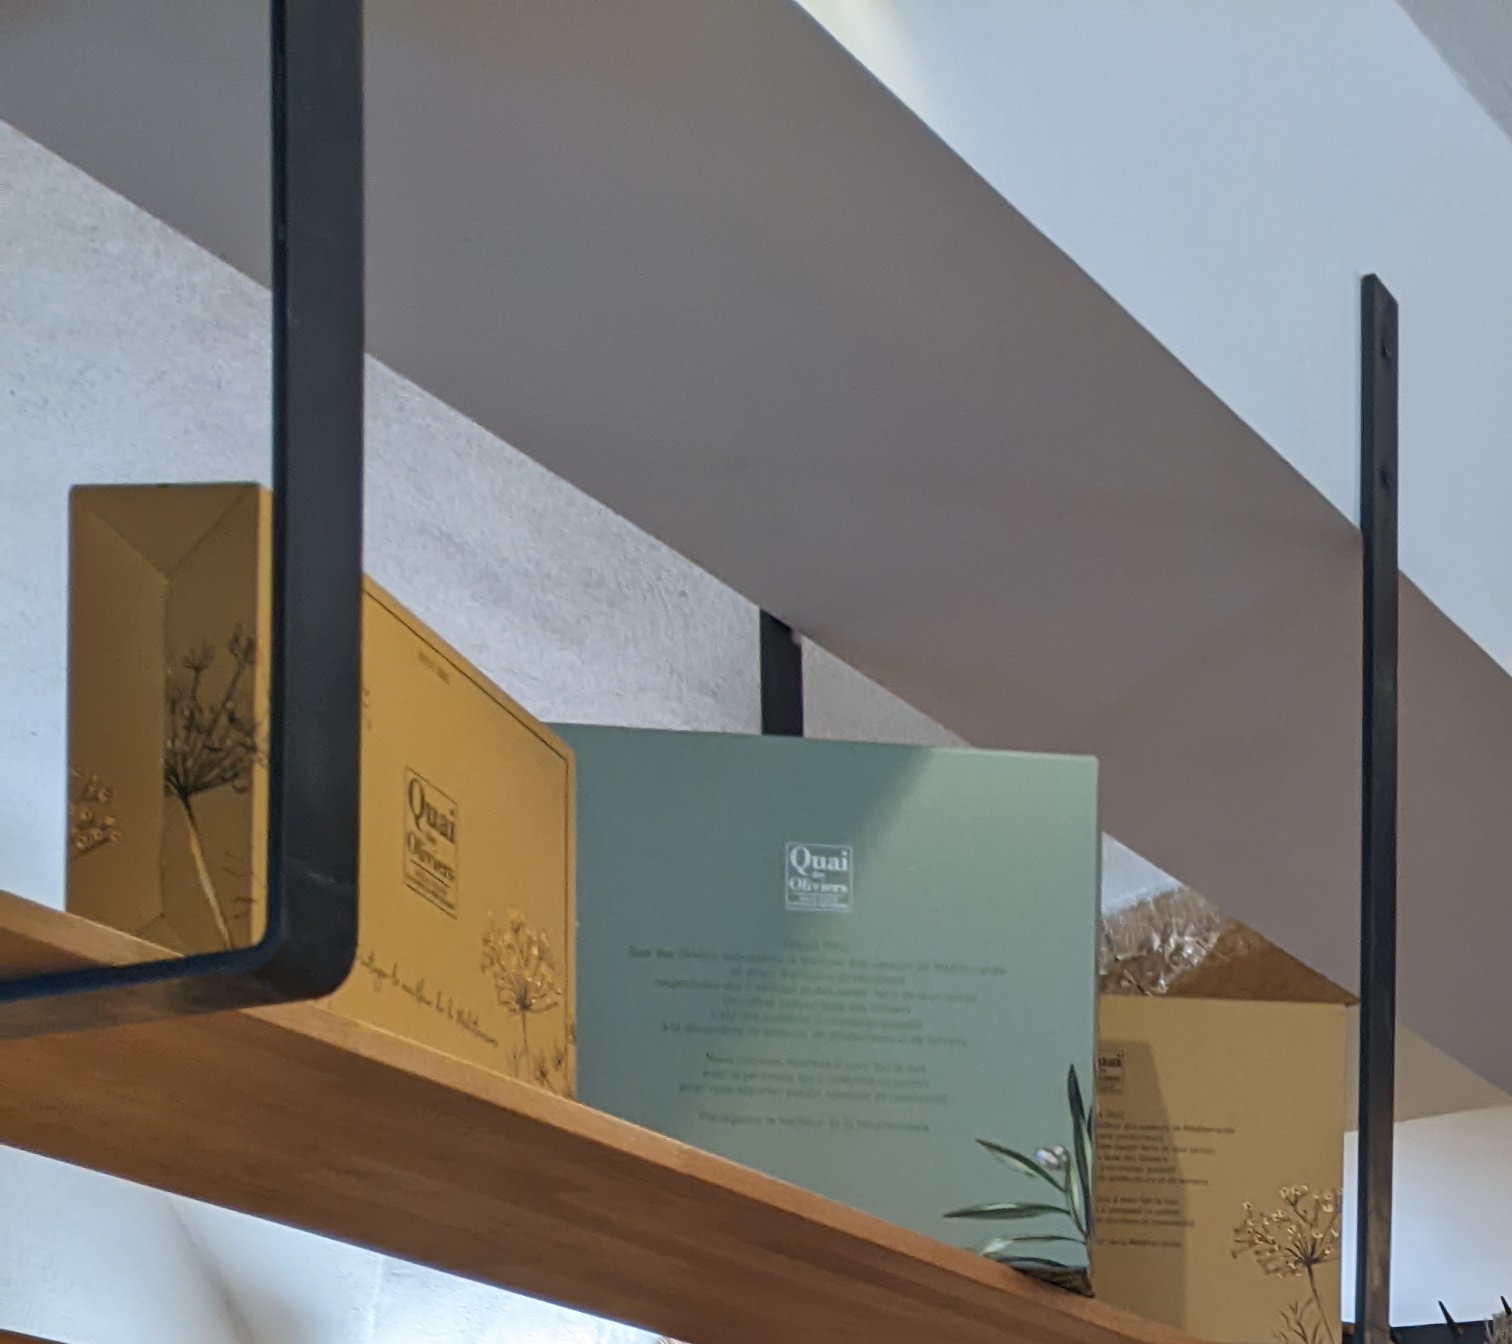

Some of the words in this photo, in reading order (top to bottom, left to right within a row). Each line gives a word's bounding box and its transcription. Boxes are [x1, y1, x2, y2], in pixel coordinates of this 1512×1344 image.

[407, 777, 457, 844] Quai
[789, 845, 848, 877] Quai
[789, 876, 848, 893] Oliviers
[1098, 1053, 1121, 1067] uai
